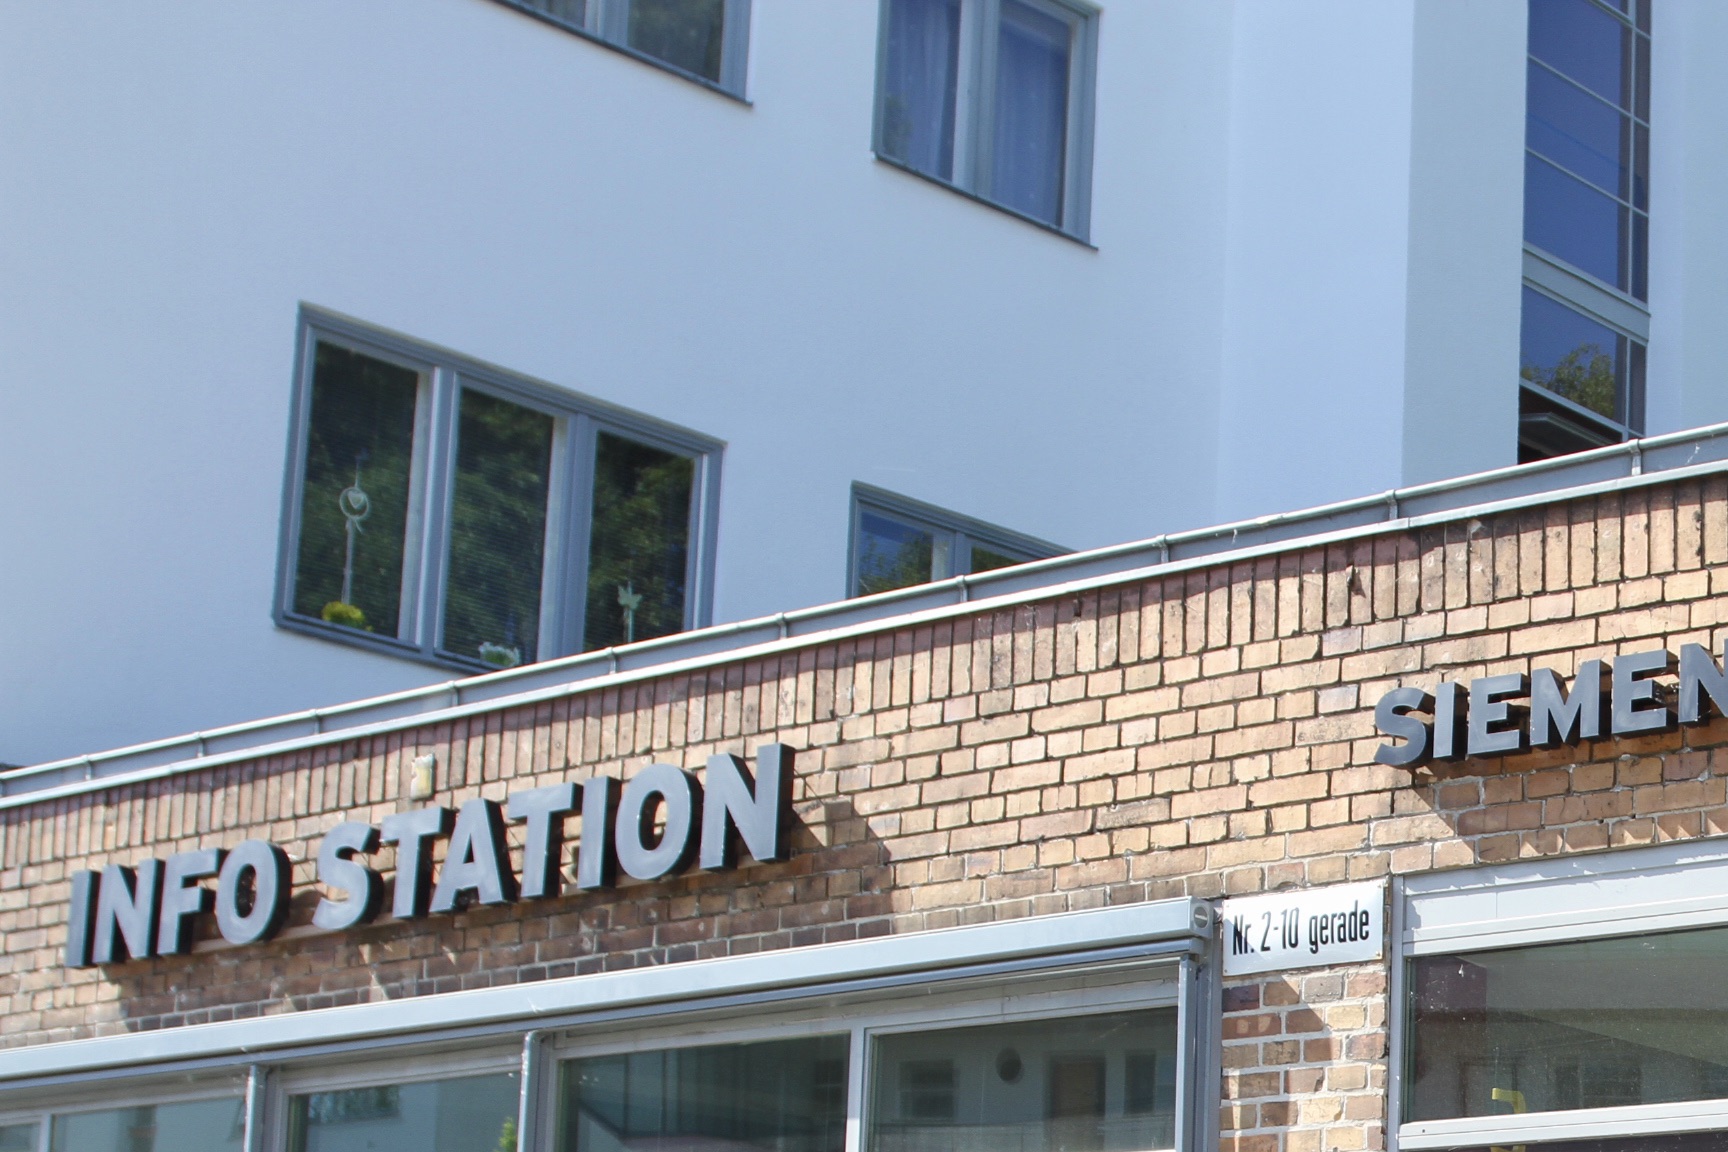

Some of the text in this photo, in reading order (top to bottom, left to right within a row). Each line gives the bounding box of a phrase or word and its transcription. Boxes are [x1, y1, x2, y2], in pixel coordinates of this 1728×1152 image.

[65, 743, 796, 968] INFO STATION
[1233, 900, 1370, 955] Nr. 2-10 gerade
